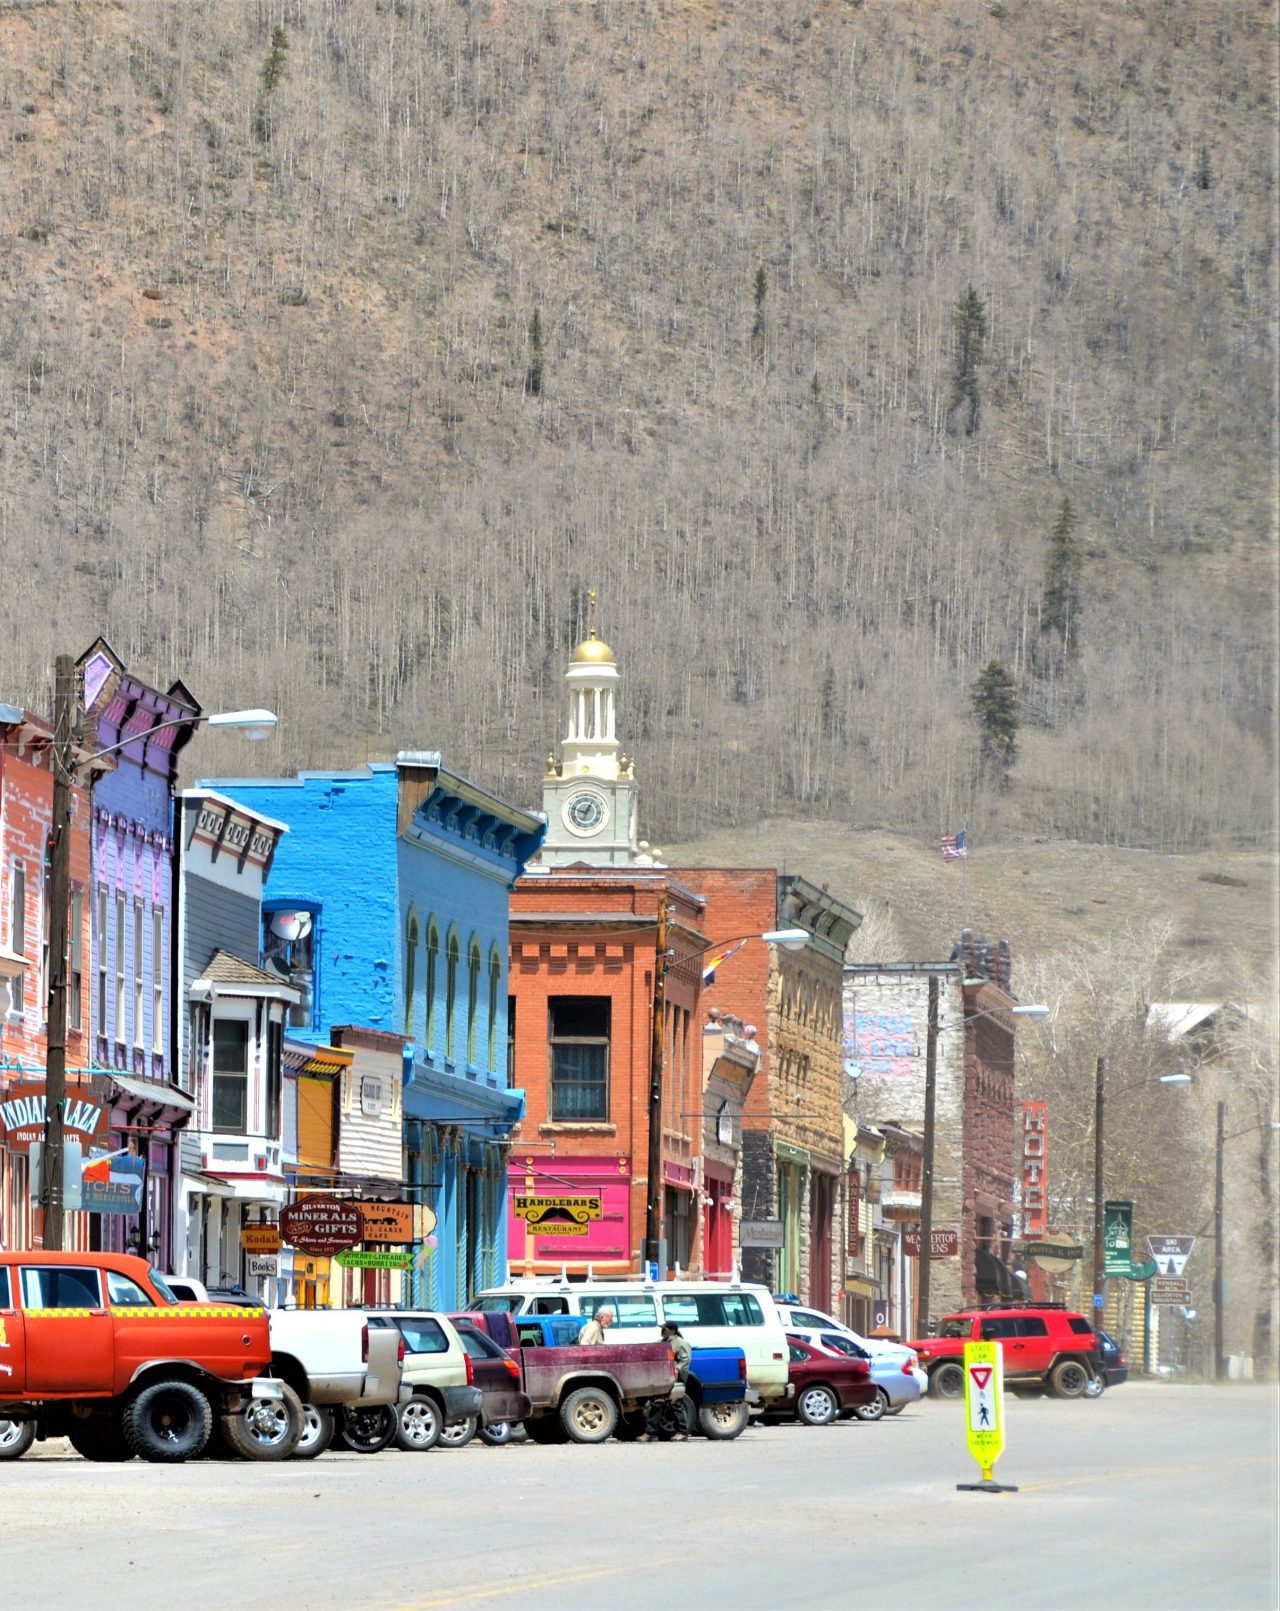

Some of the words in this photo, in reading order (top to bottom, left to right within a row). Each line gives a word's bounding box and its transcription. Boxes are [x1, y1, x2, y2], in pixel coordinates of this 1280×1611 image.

[64, 1097, 102, 1135] LAZA
[1024, 1107, 1044, 1235] HOTEL
[302, 1203, 340, 1212] SILVERTON
[516, 1198, 599, 1209] HANDLEBARS
[288, 1212, 357, 1221] MINERALS
[371, 1205, 409, 1220] MOUNTAIN
[850, 1178, 858, 1251] ANTIQUES
[315, 1224, 357, 1234] GIFTS
[246, 1235, 278, 1243] Kodak
[905, 1233, 956, 1243] WEAERTOP
[916, 1243, 949, 1253] WENS
[252, 1261, 275, 1271] Books
